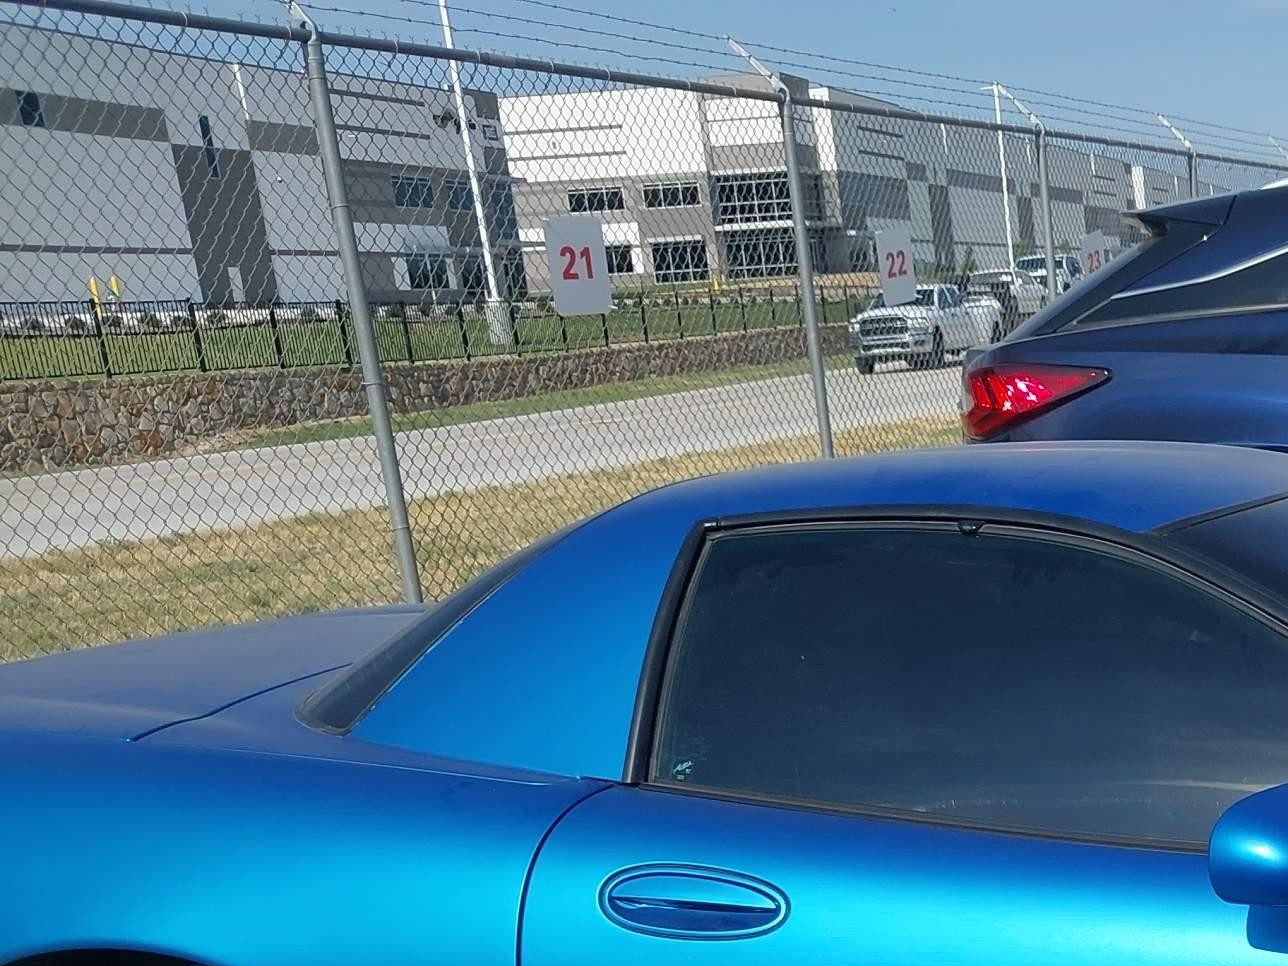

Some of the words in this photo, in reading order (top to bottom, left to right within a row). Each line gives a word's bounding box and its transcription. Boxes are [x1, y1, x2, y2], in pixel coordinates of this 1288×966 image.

[560, 246, 594, 280] 21
[886, 250, 908, 279] 22
[1087, 250, 1101, 274] 23
